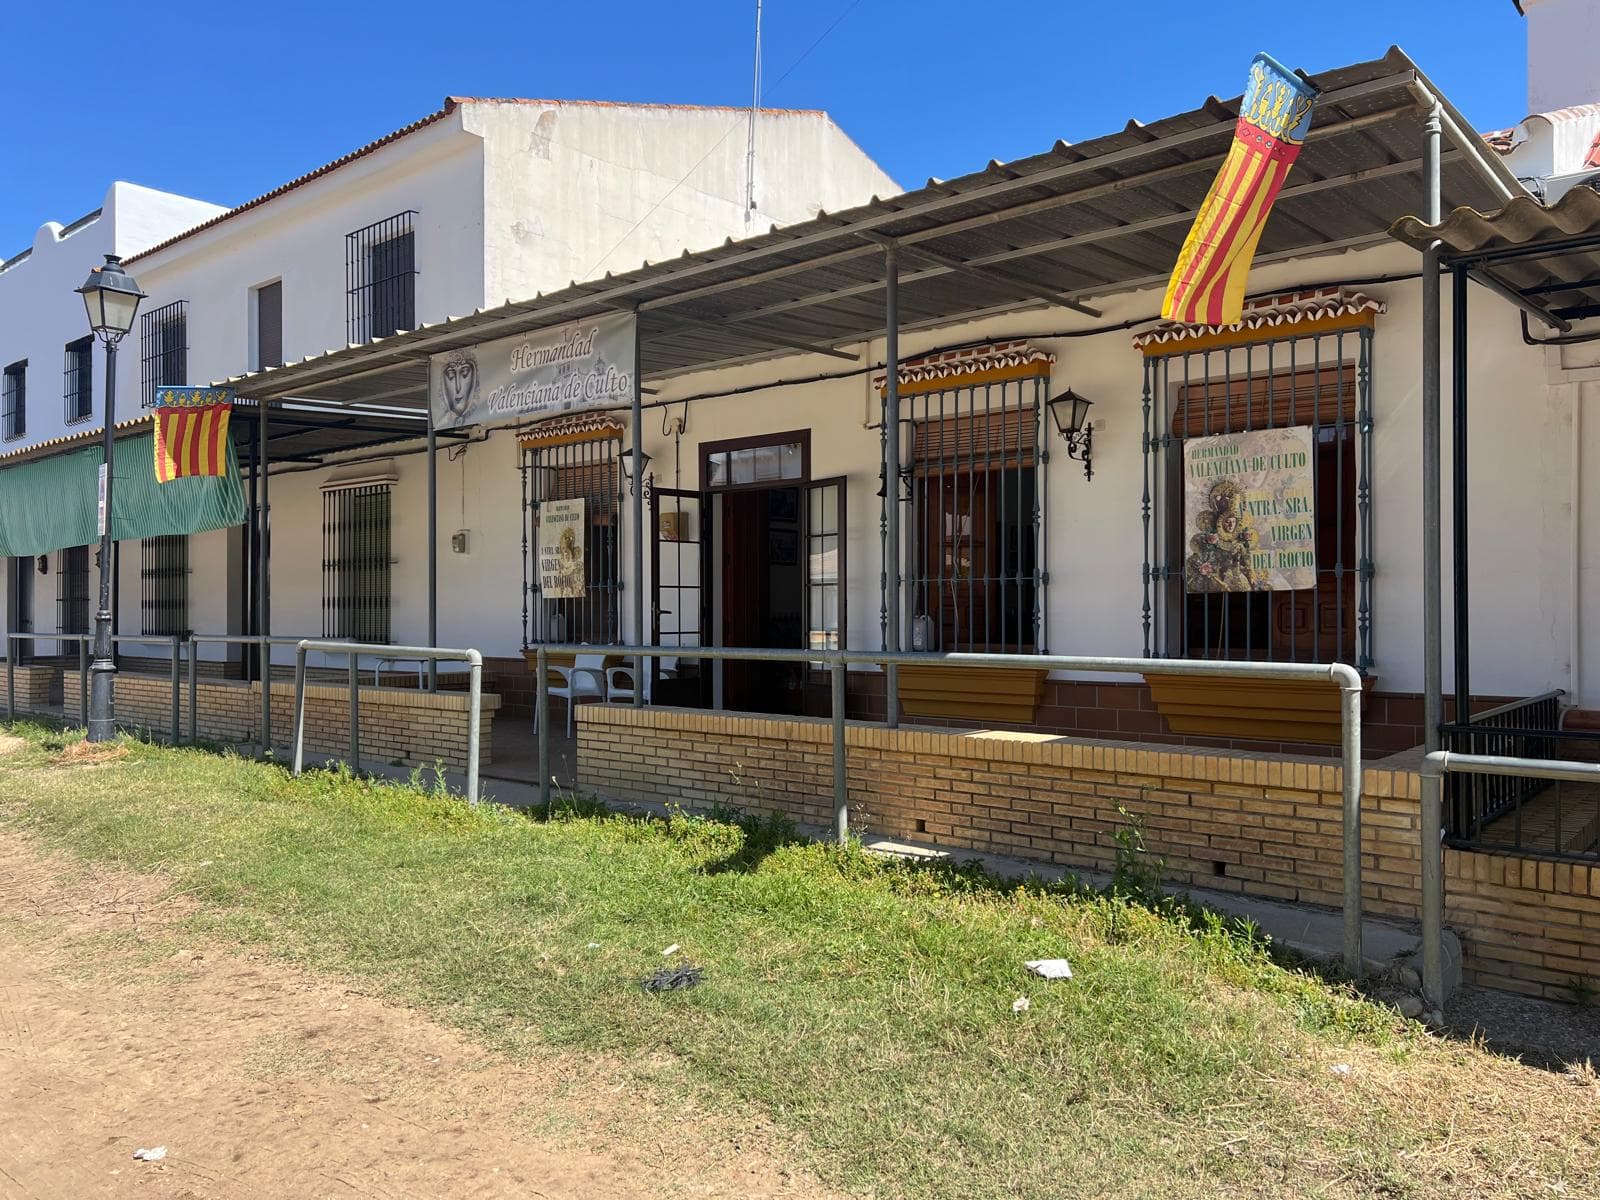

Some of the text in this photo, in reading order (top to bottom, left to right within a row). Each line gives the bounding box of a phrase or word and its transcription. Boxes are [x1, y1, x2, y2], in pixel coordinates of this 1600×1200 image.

[511, 328, 598, 372] Hermandad
[488, 366, 629, 412] Valenciana de Culto
[1190, 452, 1306, 478] VALENCIANA DE CULTO
[1248, 499, 1281, 516] NTRA.
[1285, 496, 1312, 513] SRA.
[1271, 523, 1312, 541] VIRGEN
[1252, 553, 1275, 569] DEL
